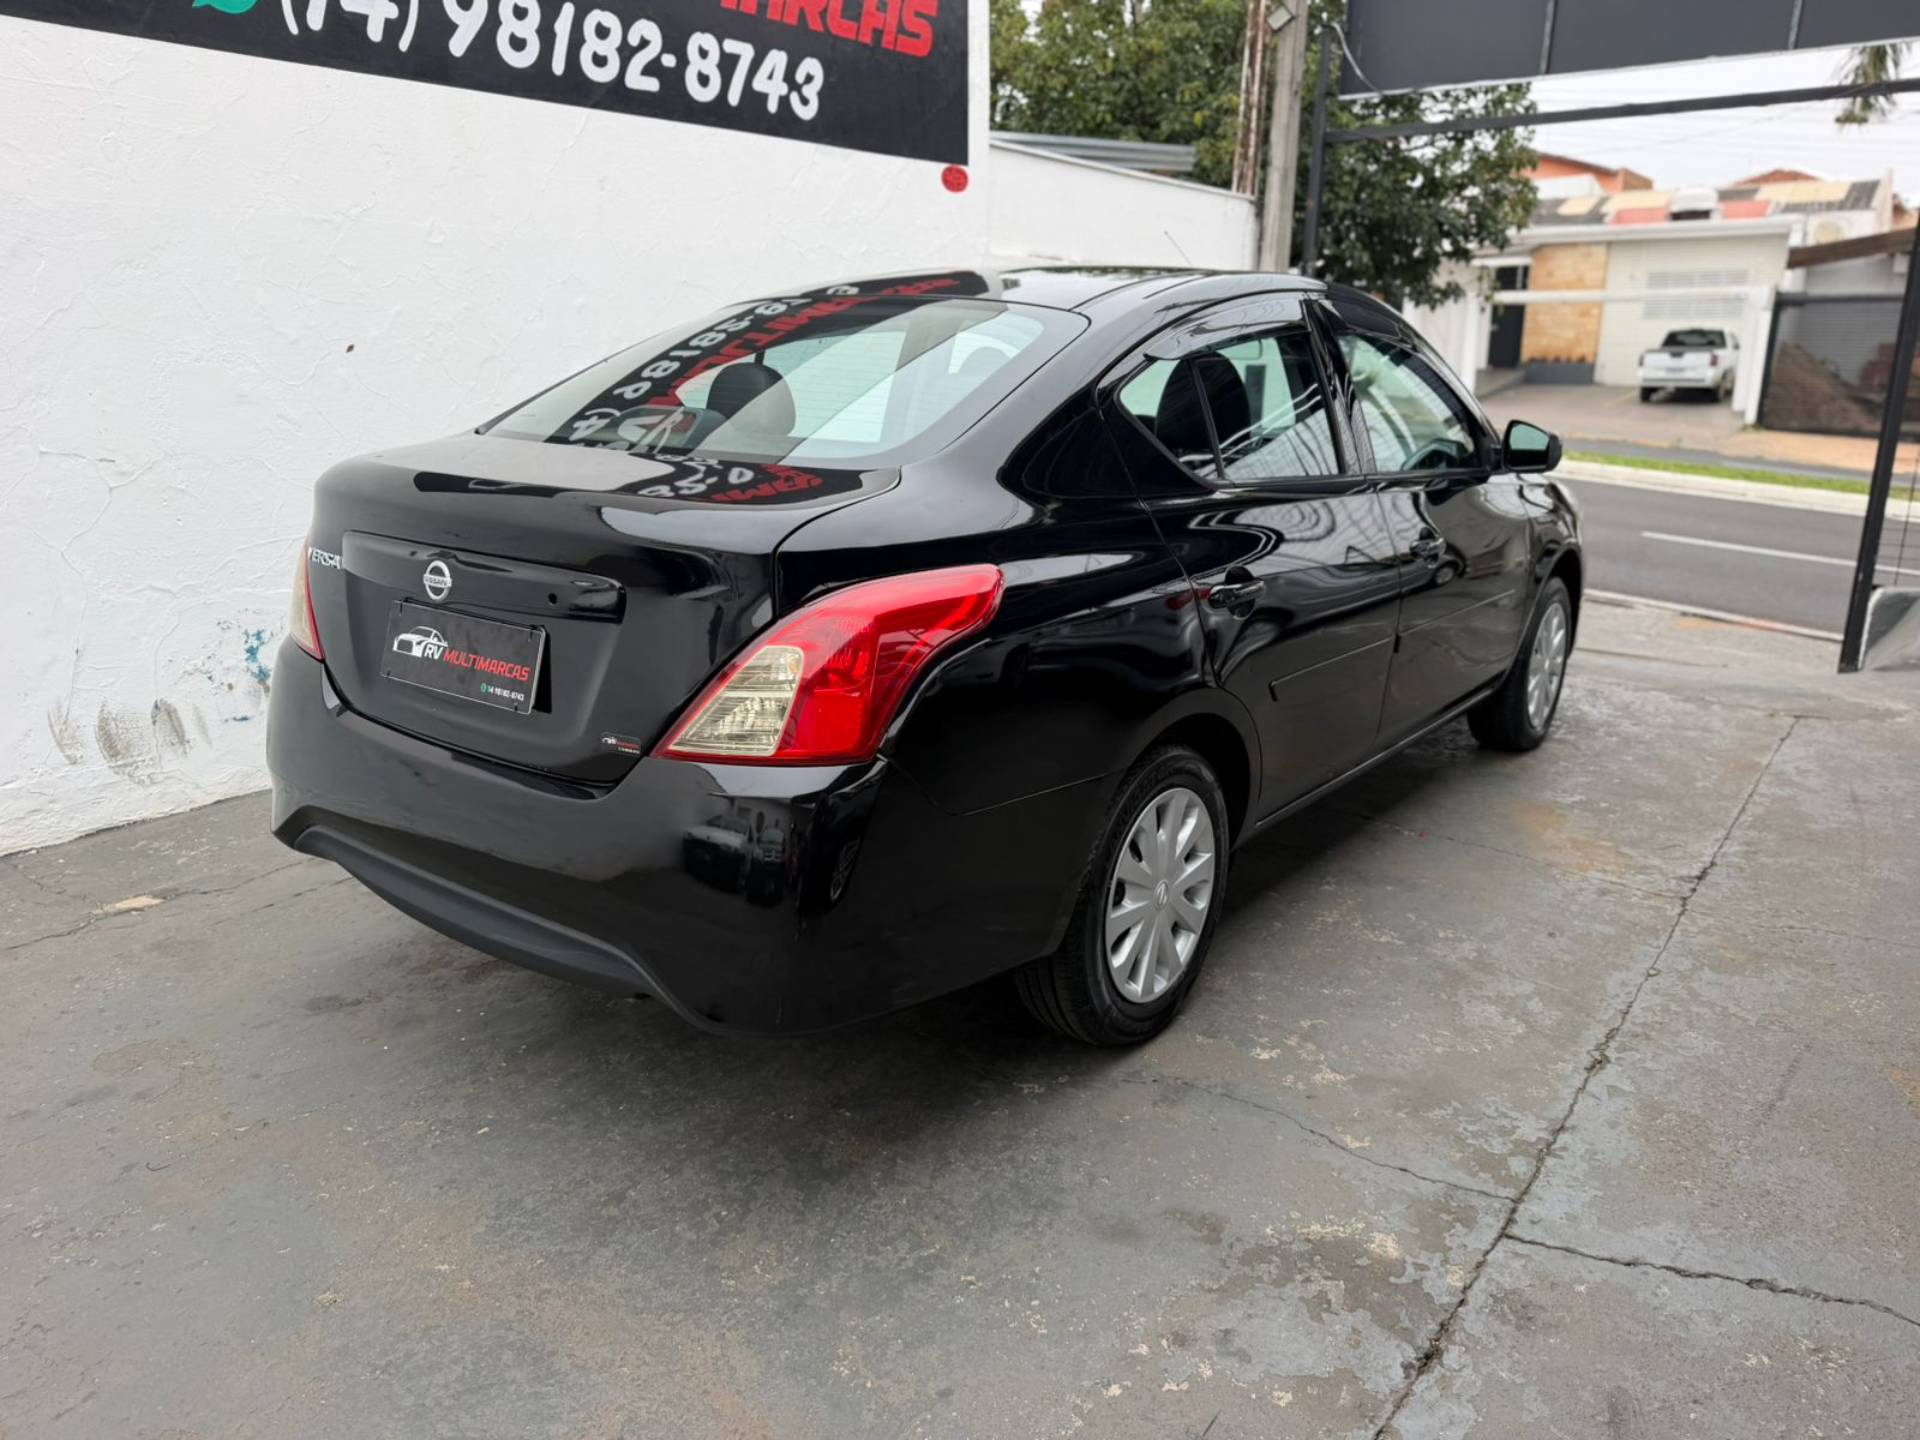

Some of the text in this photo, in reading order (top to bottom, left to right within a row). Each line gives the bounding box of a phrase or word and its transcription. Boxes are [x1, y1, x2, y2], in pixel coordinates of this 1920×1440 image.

[720, 0, 938, 58] RCAS
[442, 0, 824, 120] 98182-8743
[424, 643, 530, 681] RV MULTIMARCAS
